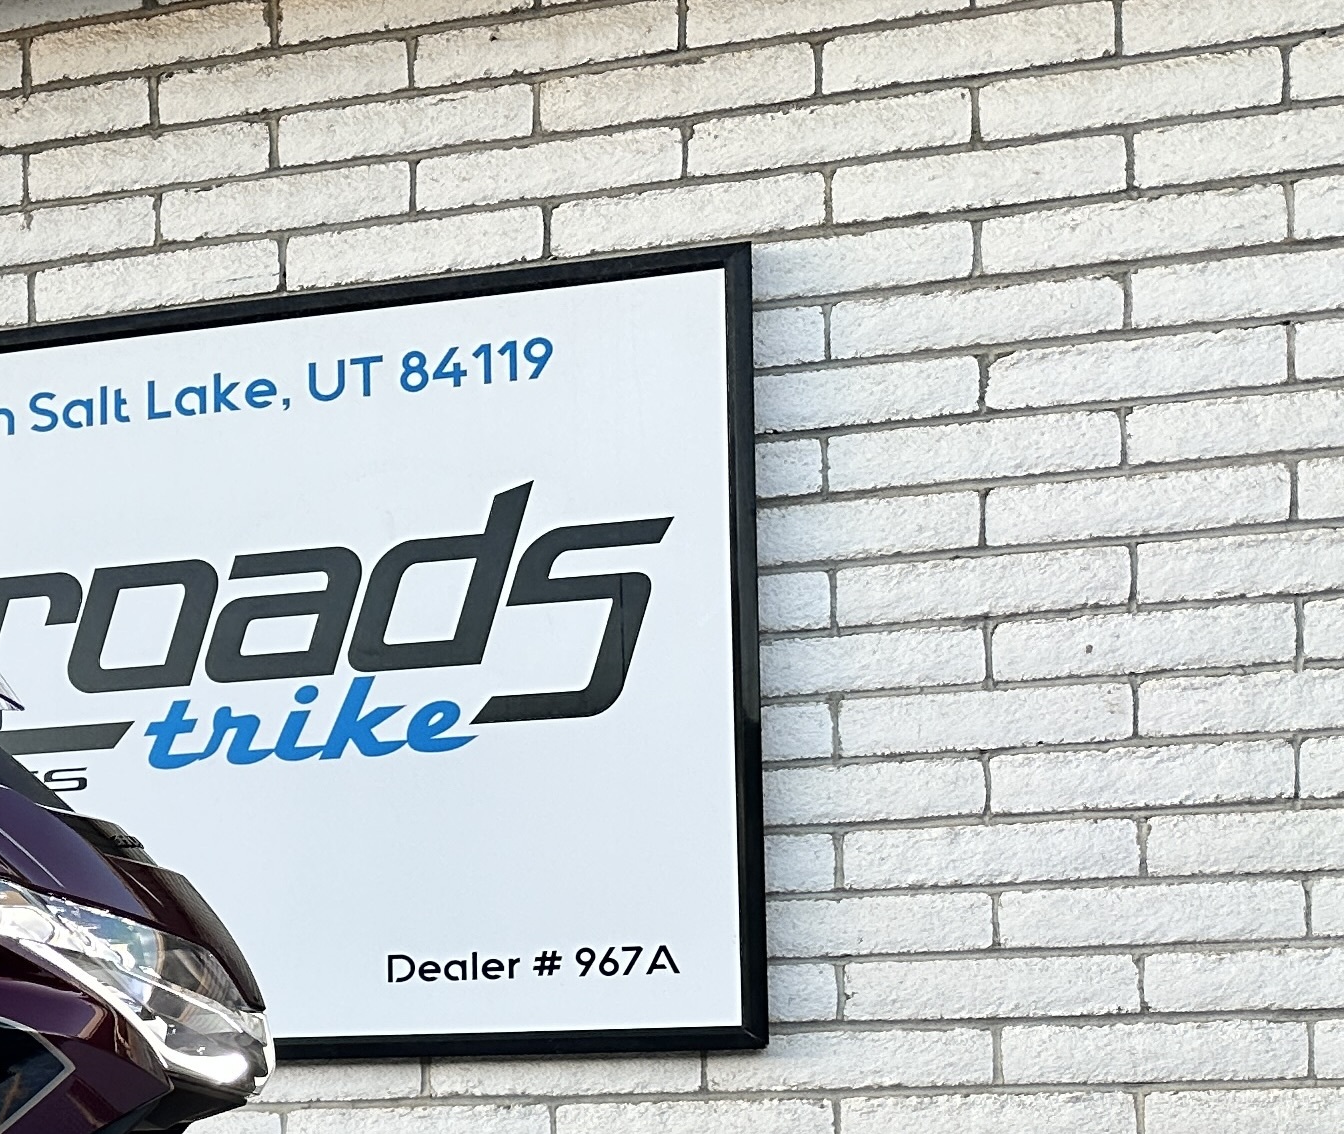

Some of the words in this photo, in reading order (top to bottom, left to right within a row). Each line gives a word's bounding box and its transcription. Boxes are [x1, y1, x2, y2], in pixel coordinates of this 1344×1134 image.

[28, 385, 131, 433] Salt
[147, 372, 292, 421] Lake,
[308, 354, 384, 402] UT
[399, 336, 555, 393] 84119
[144, 675, 479, 770] trike
[387, 951, 521, 983] Dealer
[533, 949, 563, 976] #
[575, 945, 681, 977] 967A
